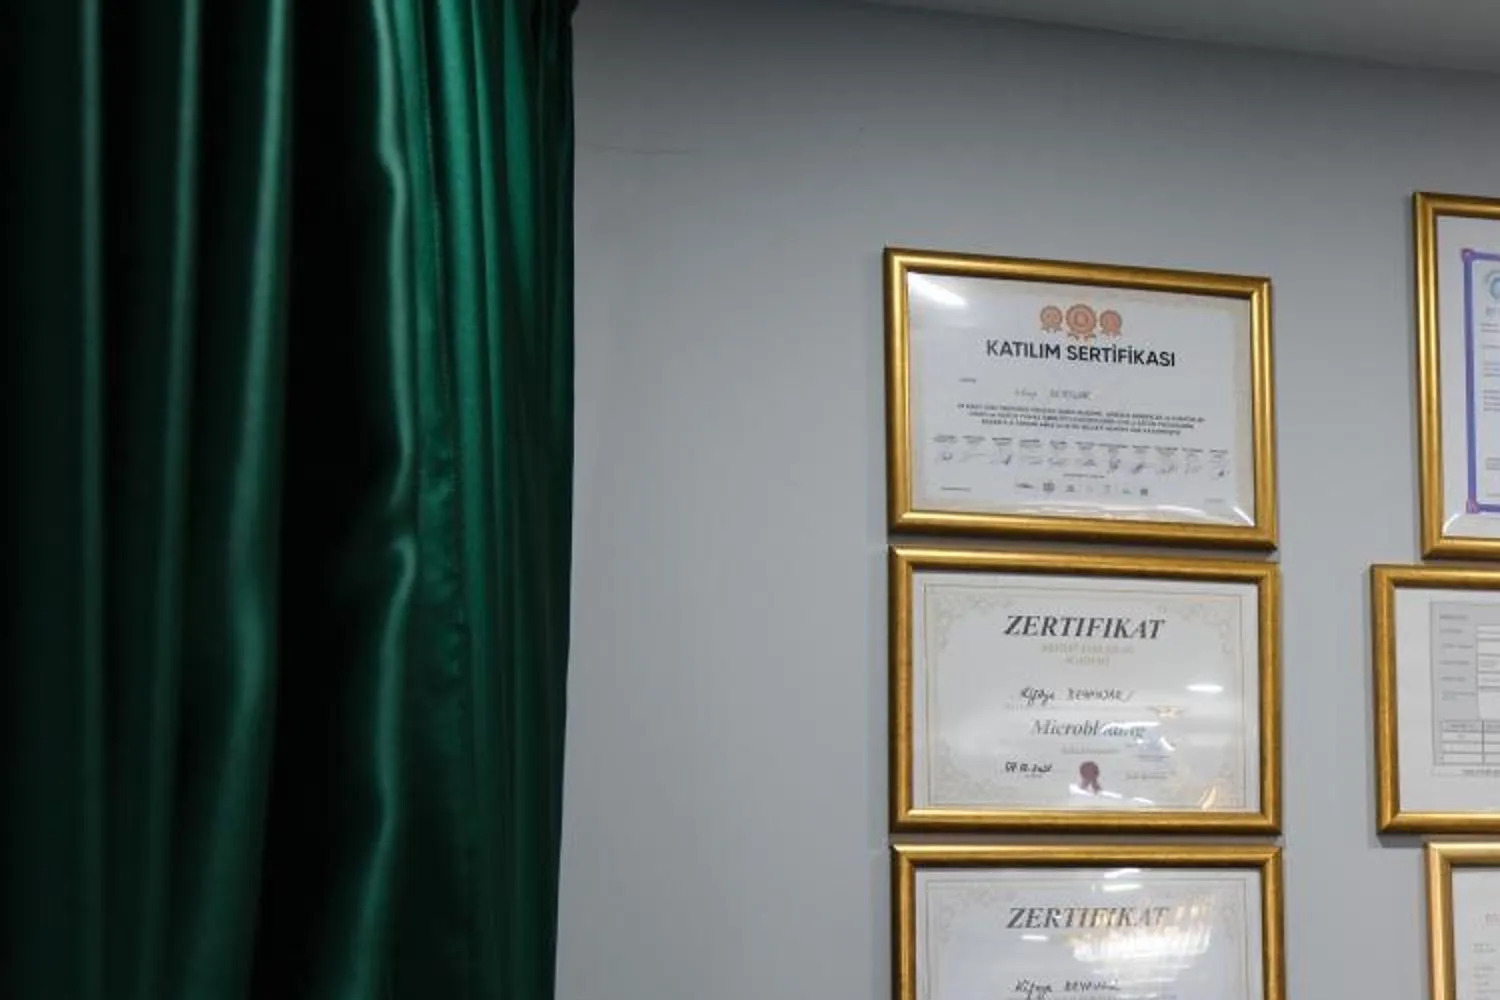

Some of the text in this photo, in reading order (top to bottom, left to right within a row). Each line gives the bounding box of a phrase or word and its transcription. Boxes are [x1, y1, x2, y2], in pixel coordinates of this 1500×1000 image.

[986, 339, 1175, 367] KATILIM SERTİFİKASI
[1003, 615, 1167, 639] ZERTIFIKAT
[1005, 907, 1170, 929] ZERTIFIKAT
